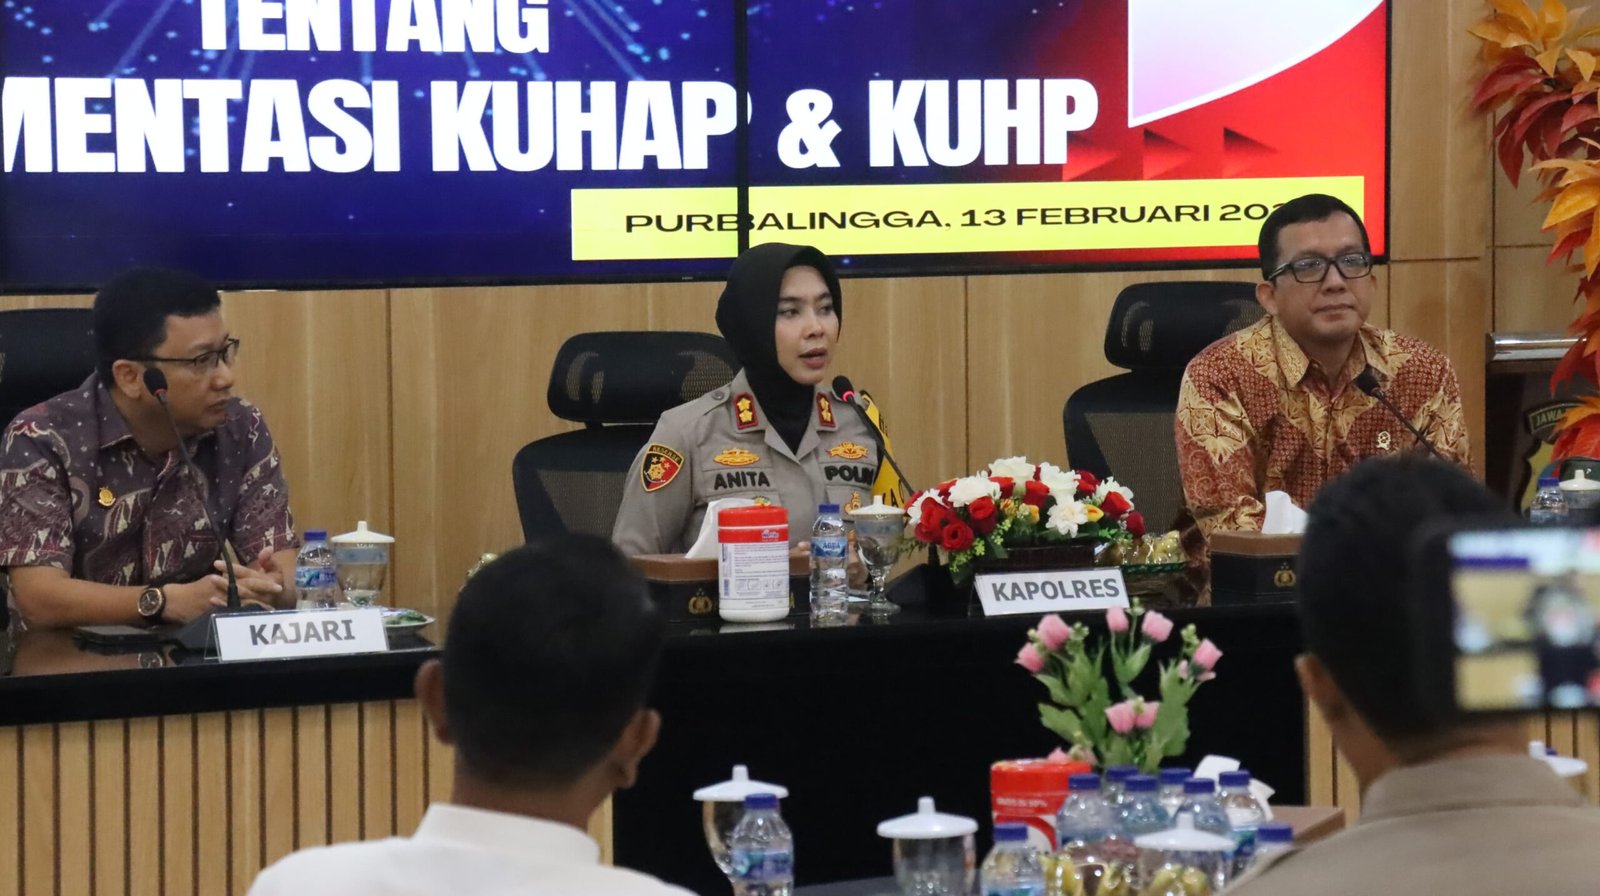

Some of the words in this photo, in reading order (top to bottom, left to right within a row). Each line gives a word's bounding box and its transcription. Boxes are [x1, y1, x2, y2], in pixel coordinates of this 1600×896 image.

[430, 80, 752, 172] KUHAP
[777, 88, 842, 169] &
[869, 78, 1099, 167] KUHP
[626, 209, 951, 233] PURBALINGGA,
[961, 209, 1006, 227] 13
[1016, 204, 1211, 226] FEBRUARI
[1219, 203, 1286, 221] 20
[714, 471, 771, 490] ANITA
[991, 578, 1120, 602] KAPOLRES
[249, 619, 356, 646] KAJARI
